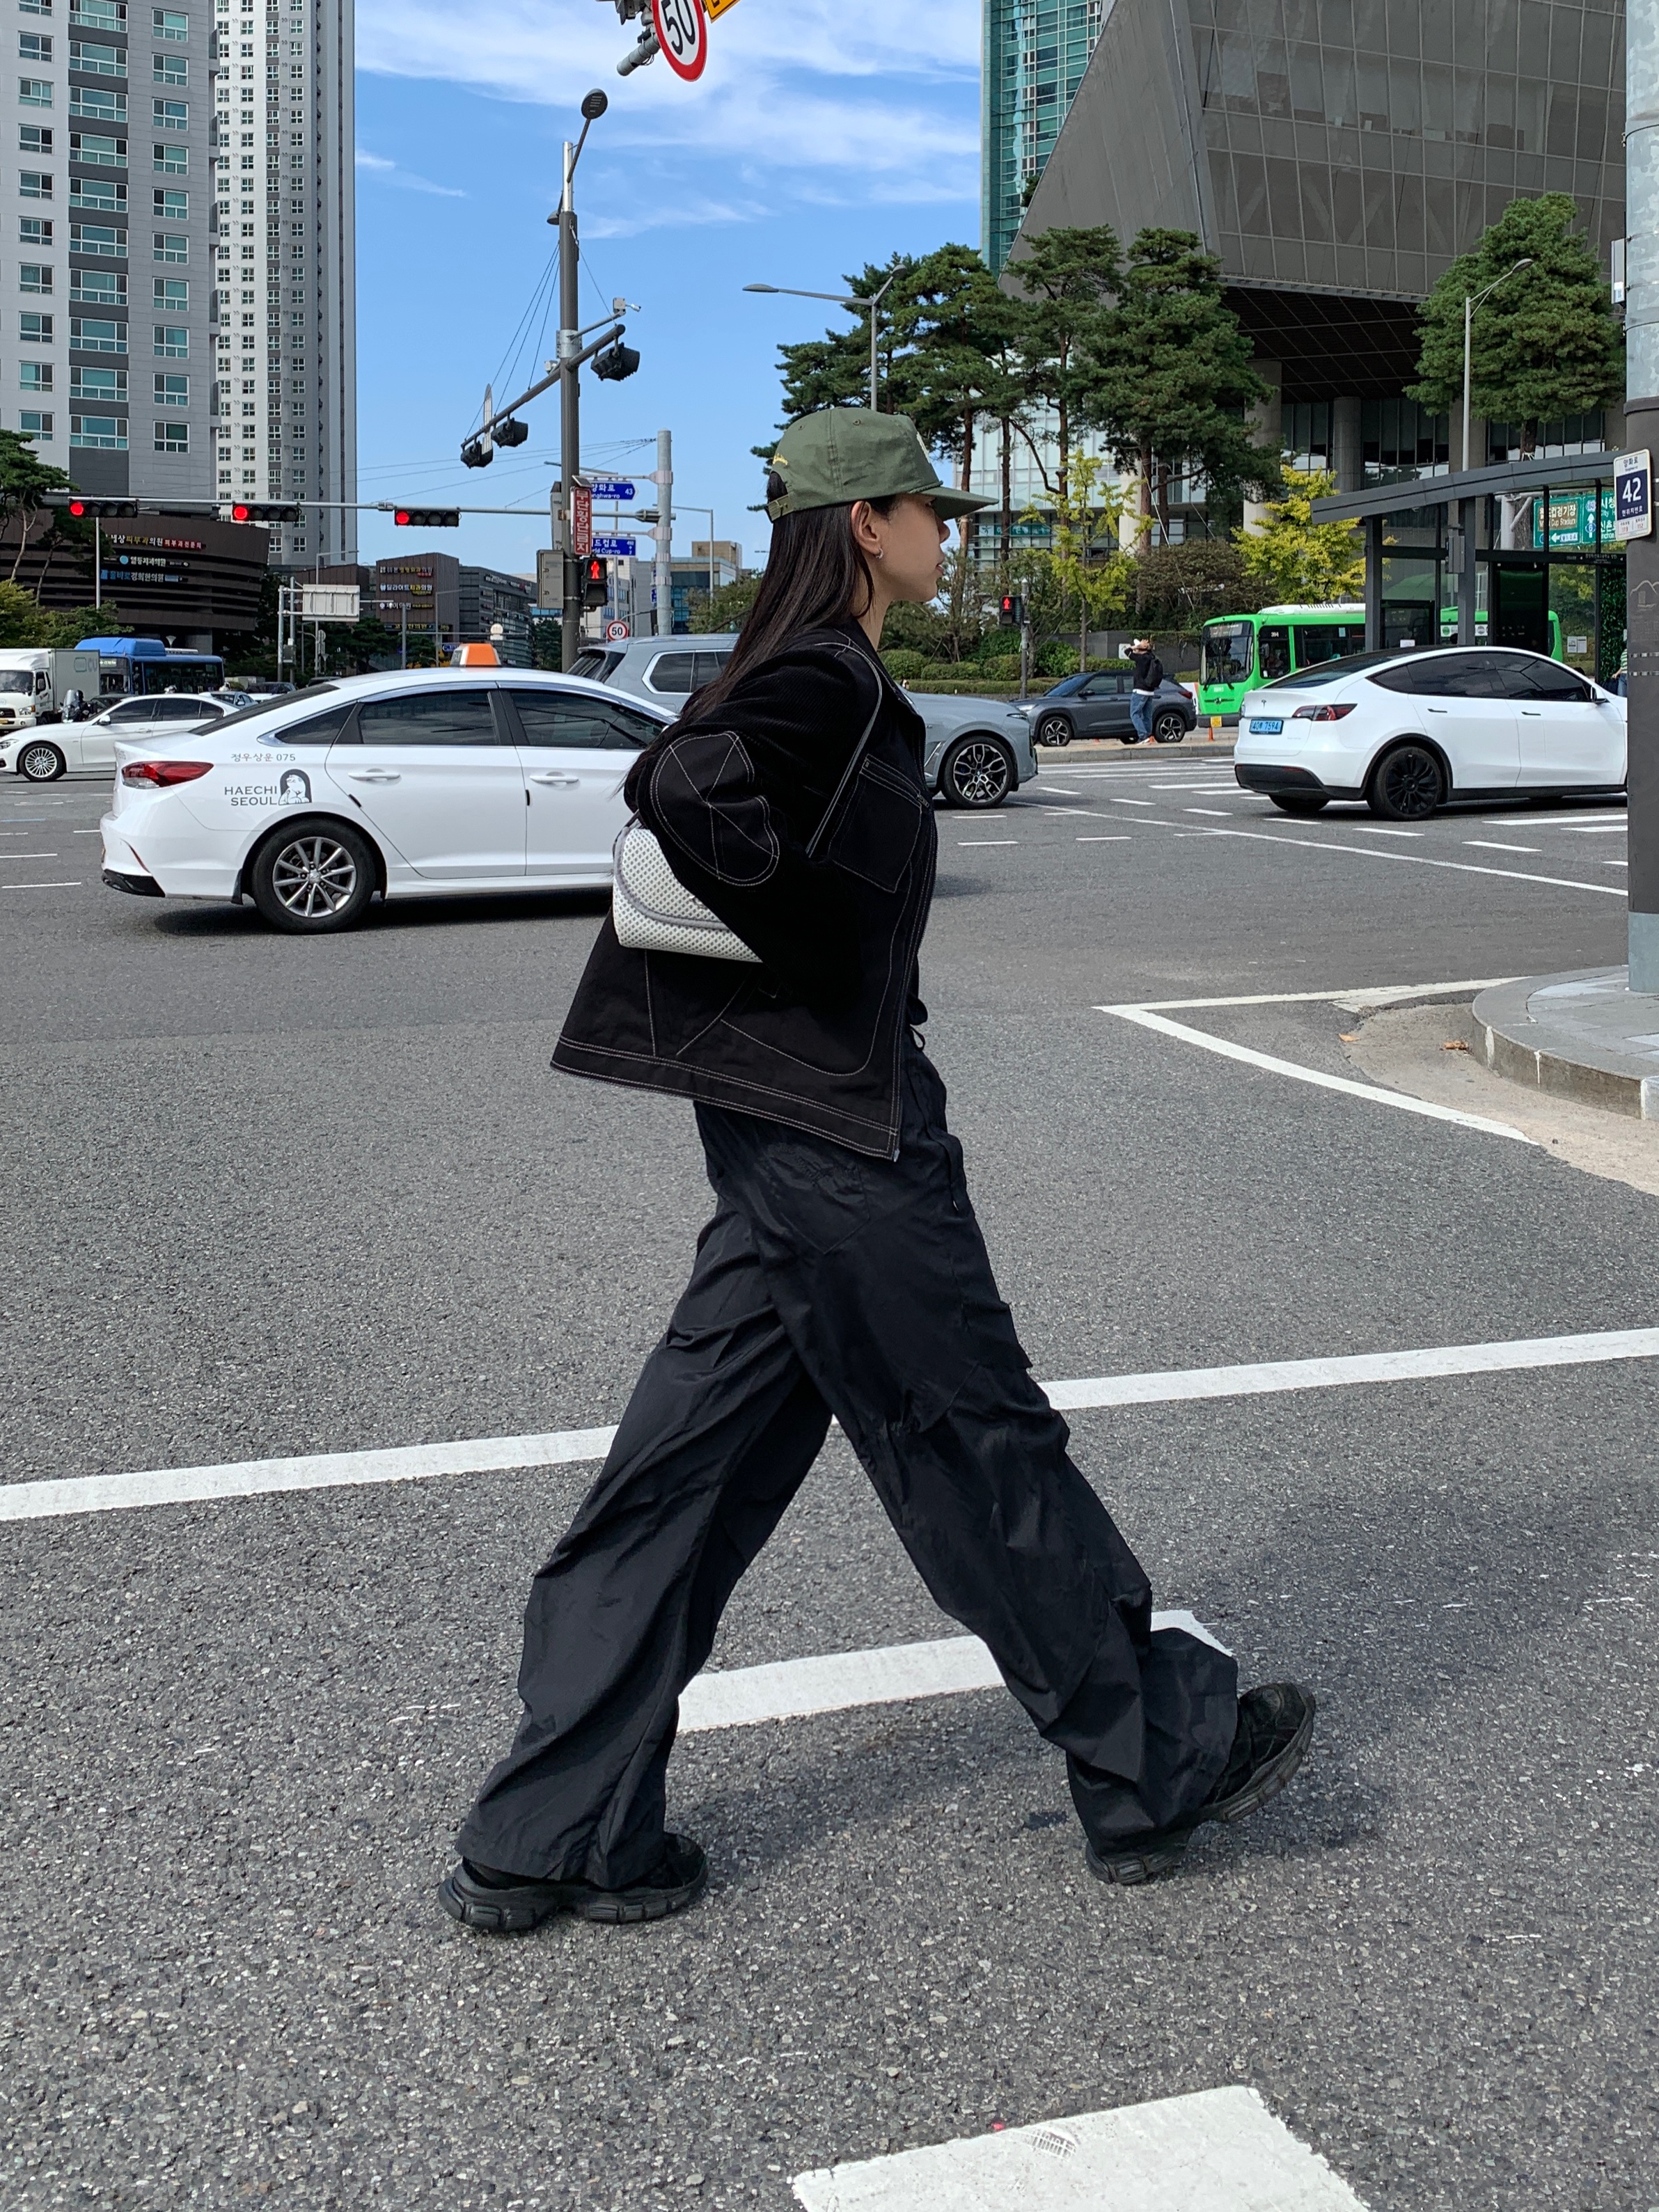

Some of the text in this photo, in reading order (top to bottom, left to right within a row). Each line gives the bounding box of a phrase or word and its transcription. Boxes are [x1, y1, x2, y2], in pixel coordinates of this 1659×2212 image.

[661, 0, 695, 56] 50
[1622, 477, 1642, 503] 42
[1539, 504, 1576, 519] 월컵경기장
[576, 489, 590, 553] 무단횡단금지
[592, 539, 618, 548] 드컵로
[611, 626, 623, 636] 50
[231, 753, 296, 762] 정우상운 075
[224, 785, 277, 795] HAECHI
[231, 797, 277, 806] SEOUL
